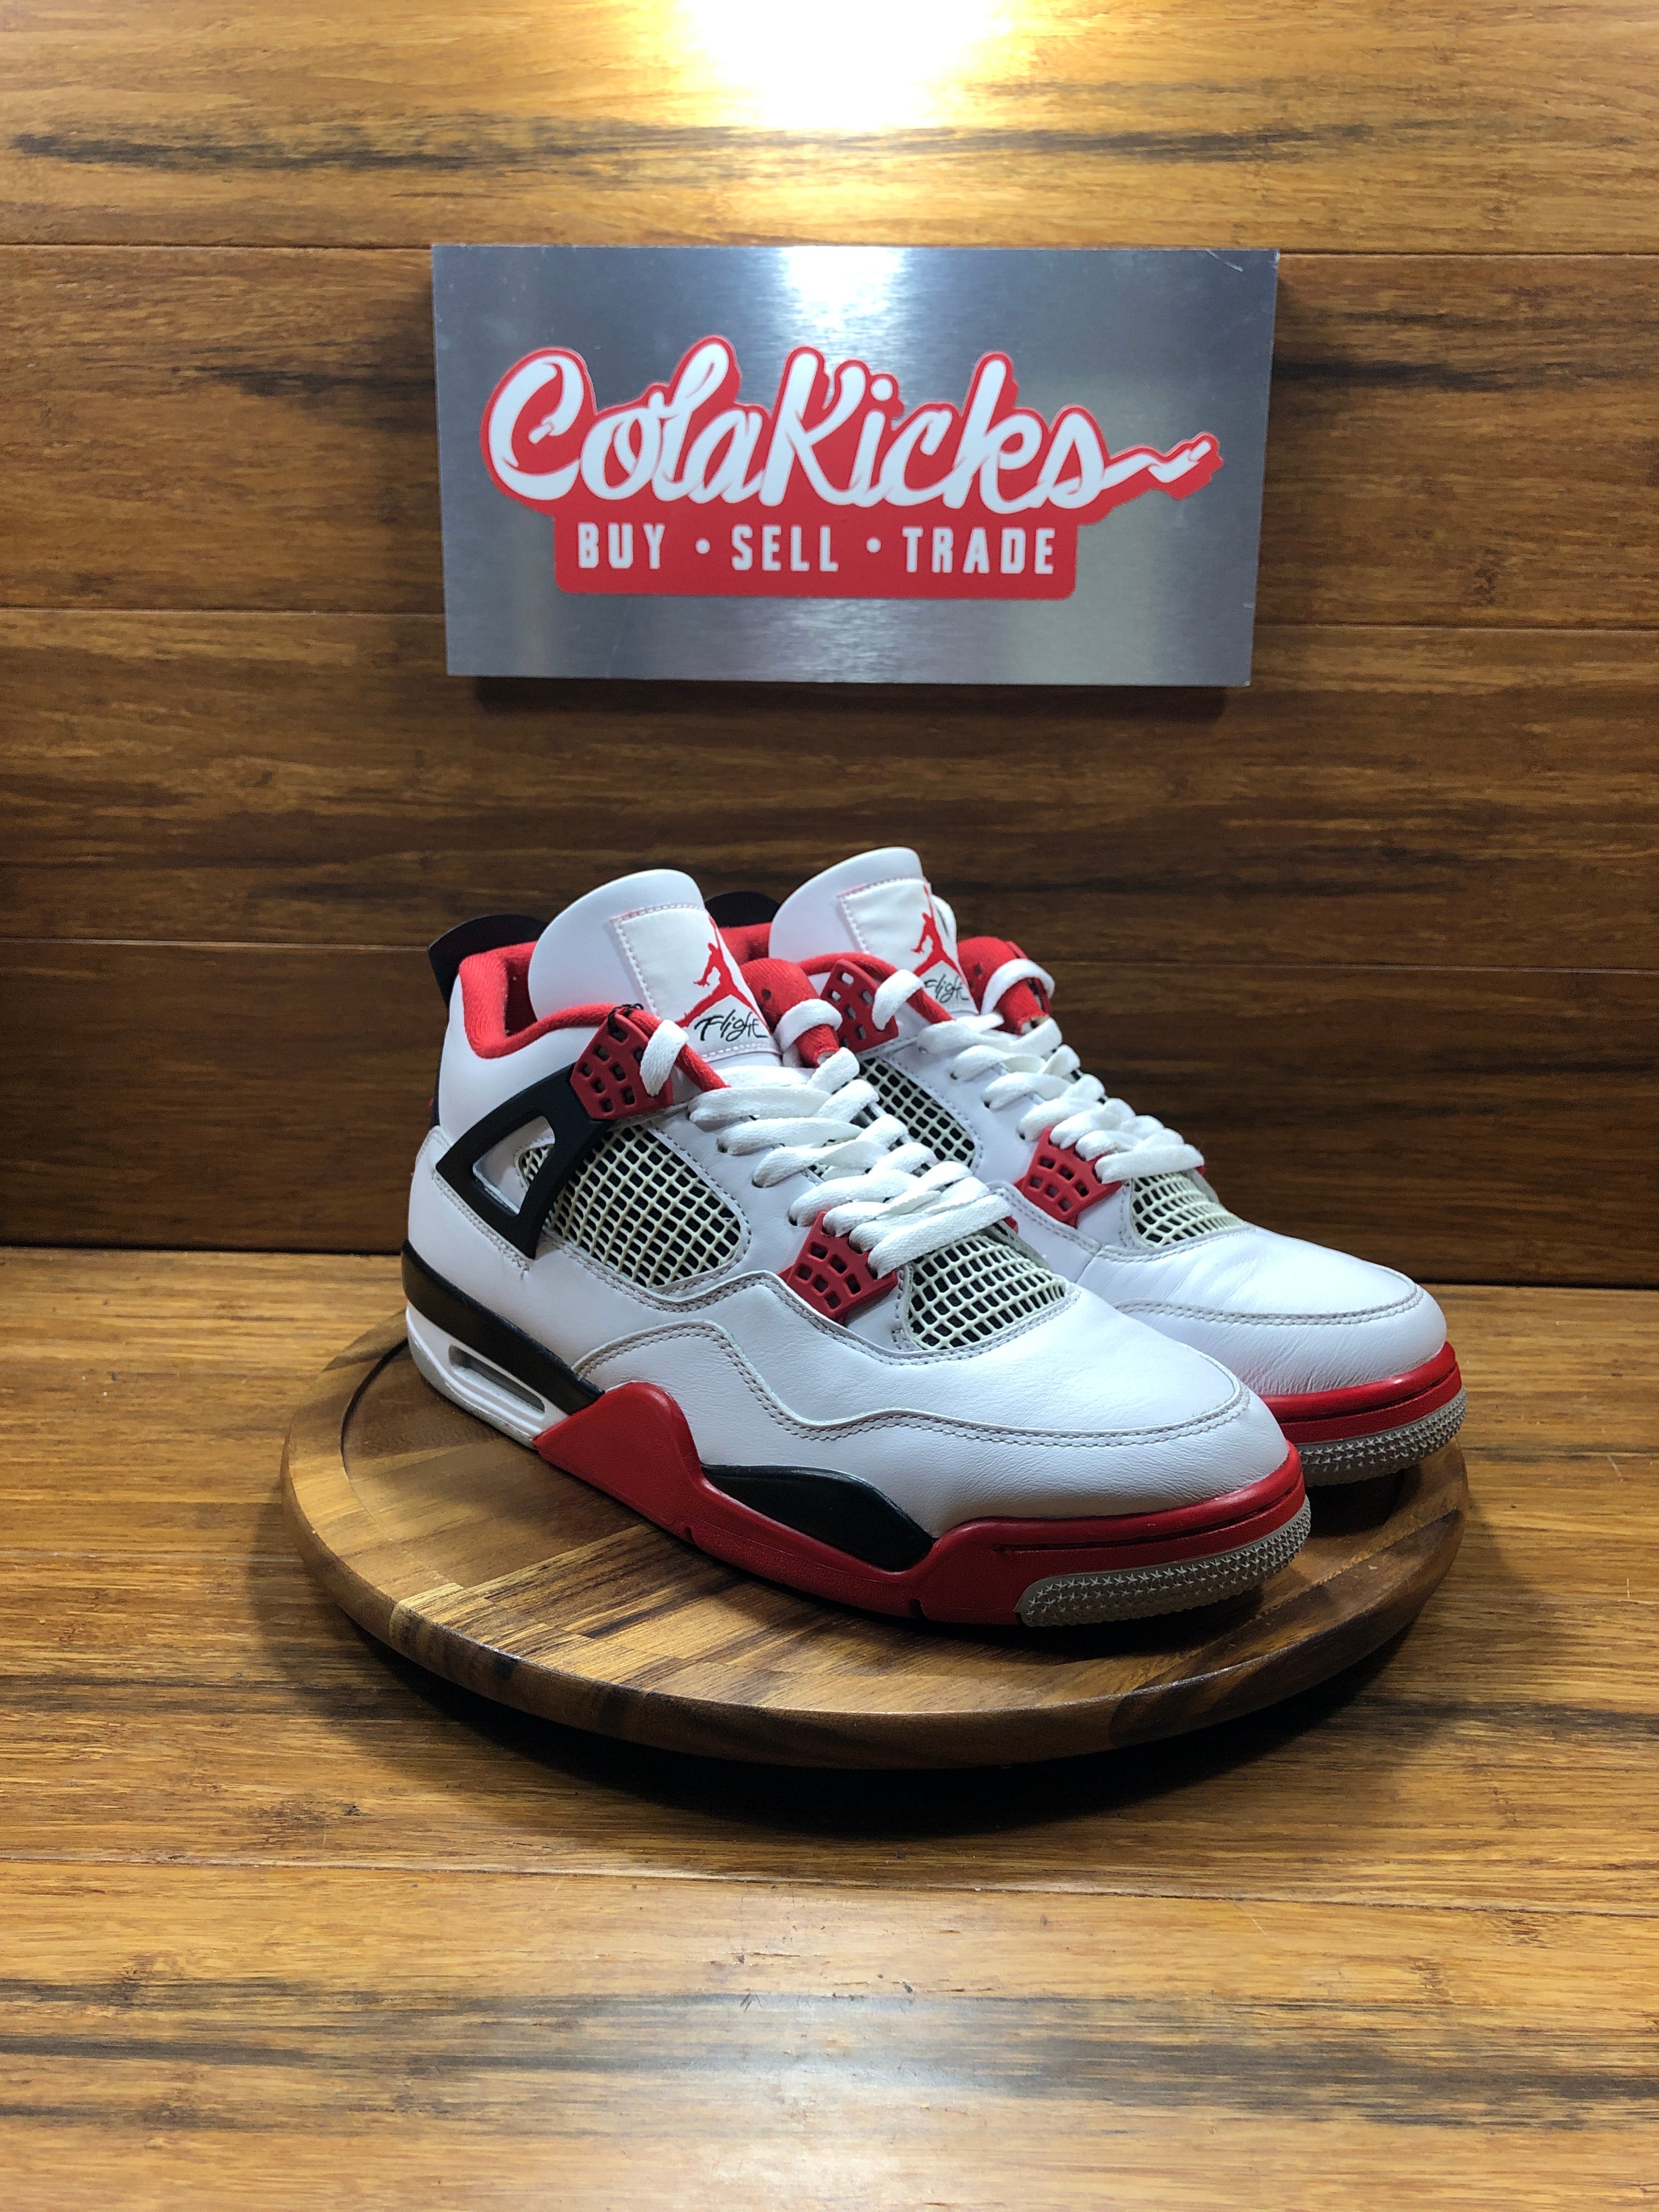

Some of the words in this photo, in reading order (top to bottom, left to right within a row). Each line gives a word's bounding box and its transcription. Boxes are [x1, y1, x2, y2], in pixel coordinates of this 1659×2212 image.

[488, 342, 1211, 514] ColaKicks
[577, 522, 665, 569] BUY
[731, 524, 839, 572] SELL
[902, 526, 1056, 574] TRADE
[694, 1009, 768, 1041] Flight
